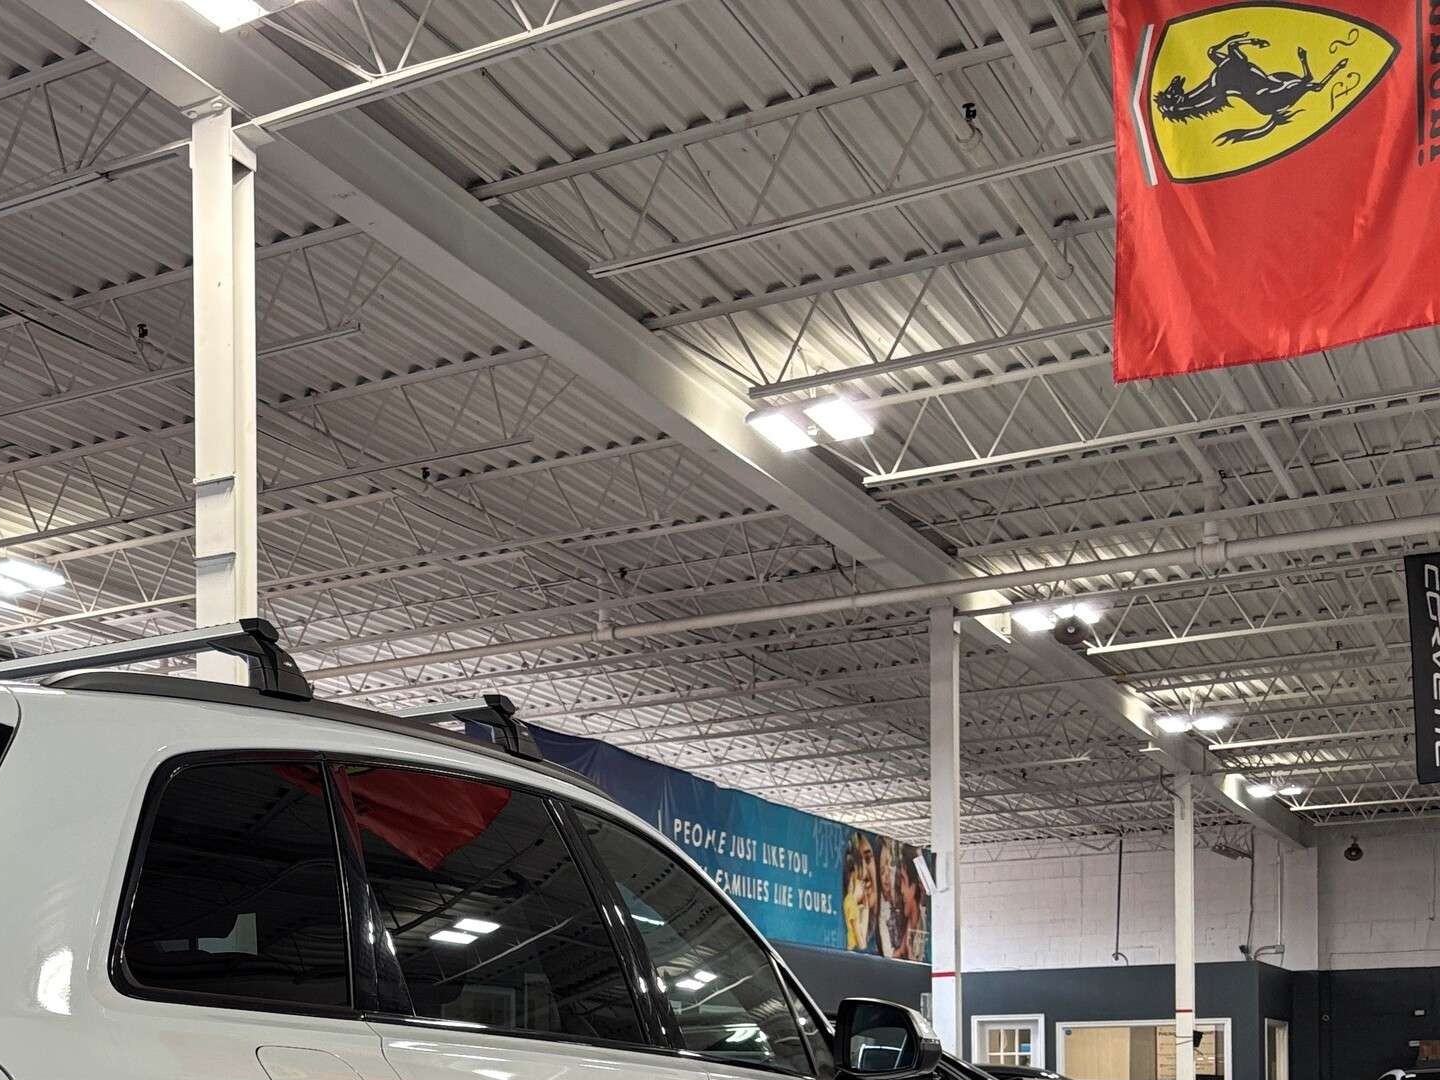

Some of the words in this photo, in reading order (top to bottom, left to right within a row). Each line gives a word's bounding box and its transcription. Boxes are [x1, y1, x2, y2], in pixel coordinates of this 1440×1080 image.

[729, 835, 757, 862] JUST
[762, 843, 785, 869] LIKE
[714, 868, 769, 902] FAMILIES
[773, 883, 794, 908] LIKE
[798, 888, 837, 916] YOURS.
